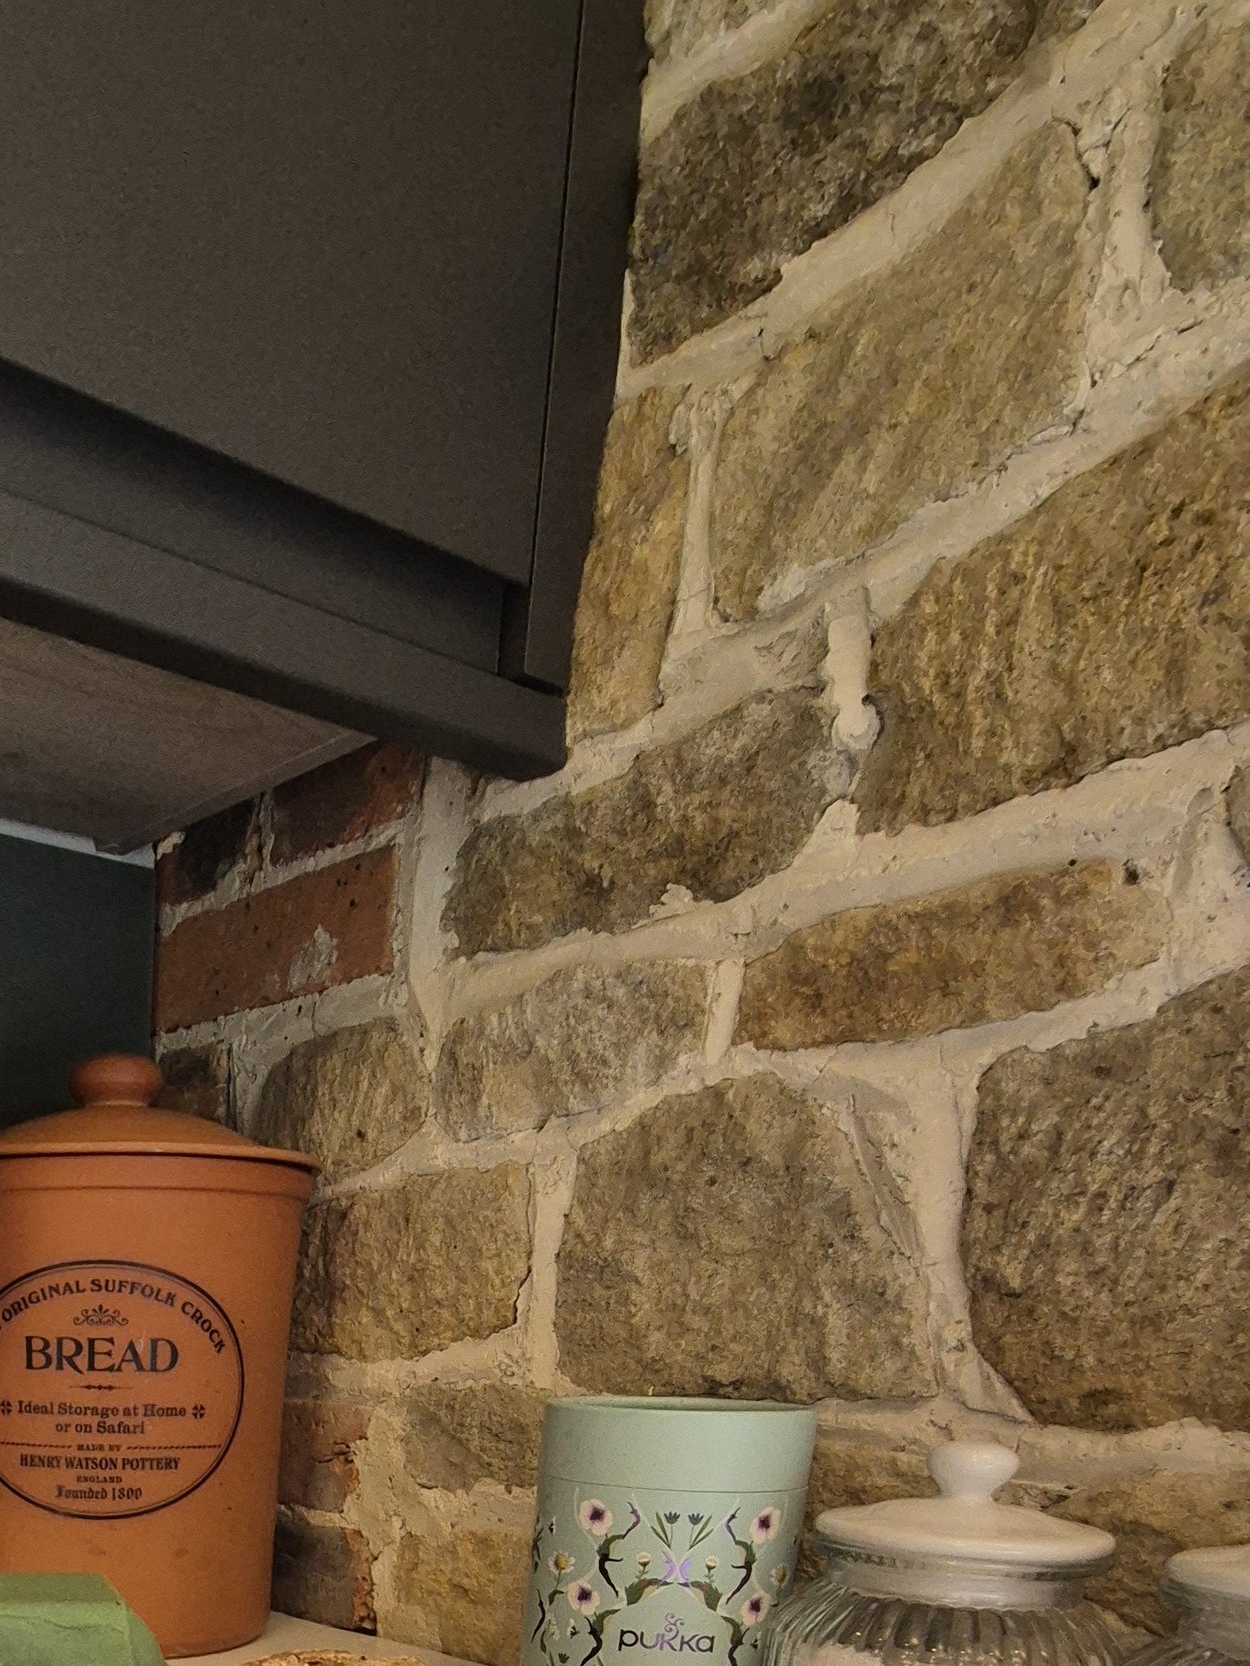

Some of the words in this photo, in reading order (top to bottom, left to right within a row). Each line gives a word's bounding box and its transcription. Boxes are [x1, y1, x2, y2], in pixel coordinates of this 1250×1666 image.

[1, 1279, 86, 1322] ORIGINAL
[89, 1278, 177, 1308] SUFFOLK
[181, 1301, 227, 1355] CROCK
[24, 1335, 180, 1375] BREAD
[17, 1400, 54, 1416] Ideal
[57, 1401, 120, 1418] Storage
[122, 1404, 139, 1417] at
[143, 1403, 187, 1418] Home
[55, 1422, 72, 1434] or
[75, 1422, 93, 1434] on
[96, 1419, 146, 1435] Safari
[76, 1443, 105, 1453] MADE
[107, 1443, 123, 1453] BY
[19, 1453, 63, 1469] HENRY
[64, 1454, 119, 1471] WATSON
[121, 1455, 181, 1471] POTTERY
[76, 1474, 123, 1484] ENGLAND
[54, 1484, 108, 1500] Founded
[111, 1485, 143, 1501] 1800
[617, 1622, 716, 1654] pukka
